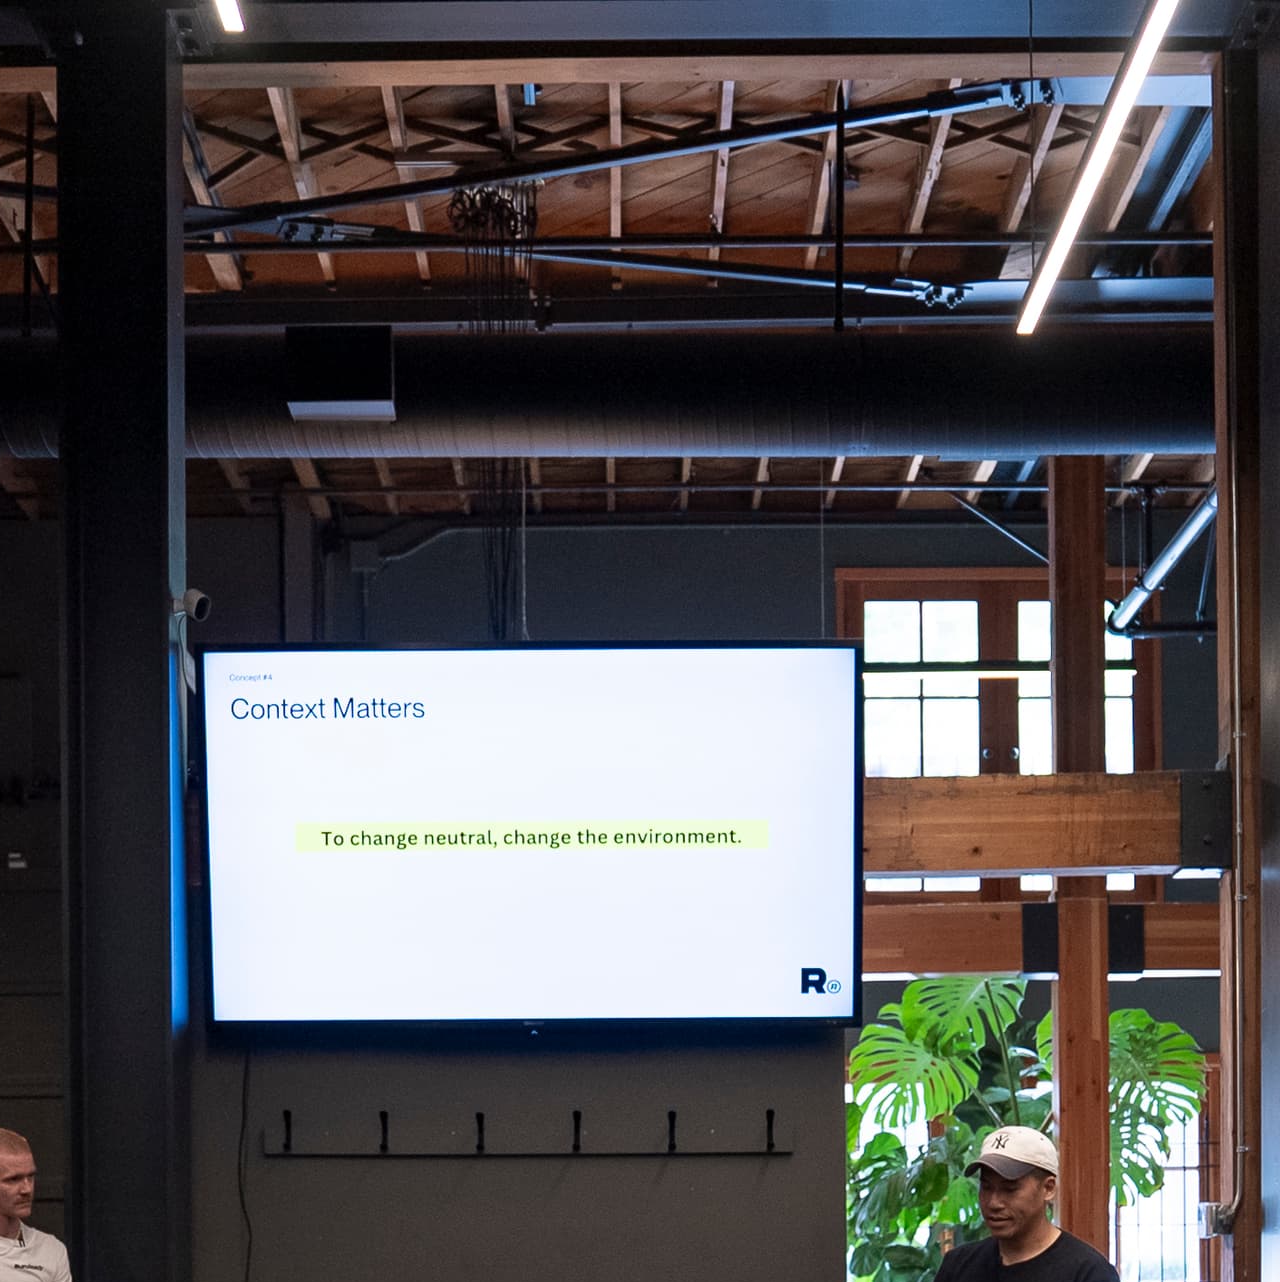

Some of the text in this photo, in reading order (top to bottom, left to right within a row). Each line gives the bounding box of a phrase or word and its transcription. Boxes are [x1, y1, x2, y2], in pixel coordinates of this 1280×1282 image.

[229, 673, 261, 682] Concept
[231, 697, 425, 719] Context Matters
[321, 828, 742, 850] To change neutral, change the environment.
[801, 967, 827, 994] R
